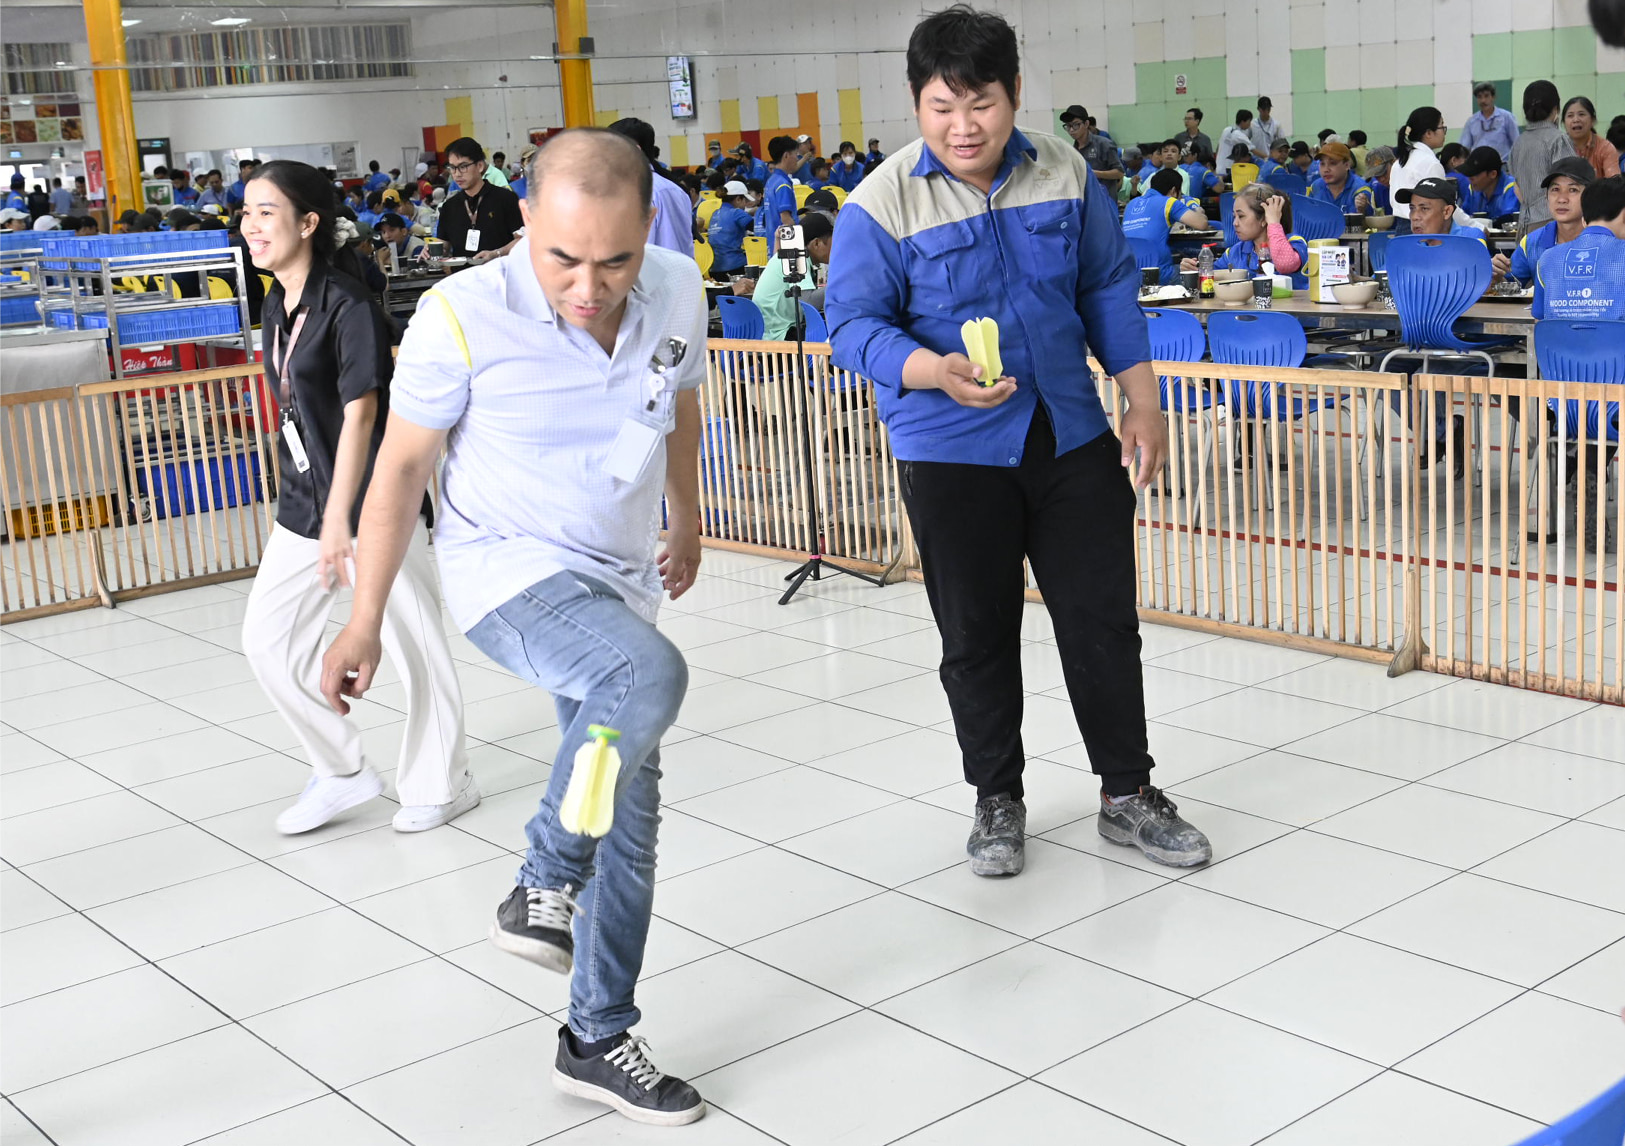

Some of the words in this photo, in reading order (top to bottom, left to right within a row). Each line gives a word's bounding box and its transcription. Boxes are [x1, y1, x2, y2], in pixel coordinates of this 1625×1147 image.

[1568, 265, 1593, 274] V.F.R
[1568, 299, 1614, 307] COMPONENT
[149, 356, 173, 368] Thàn
